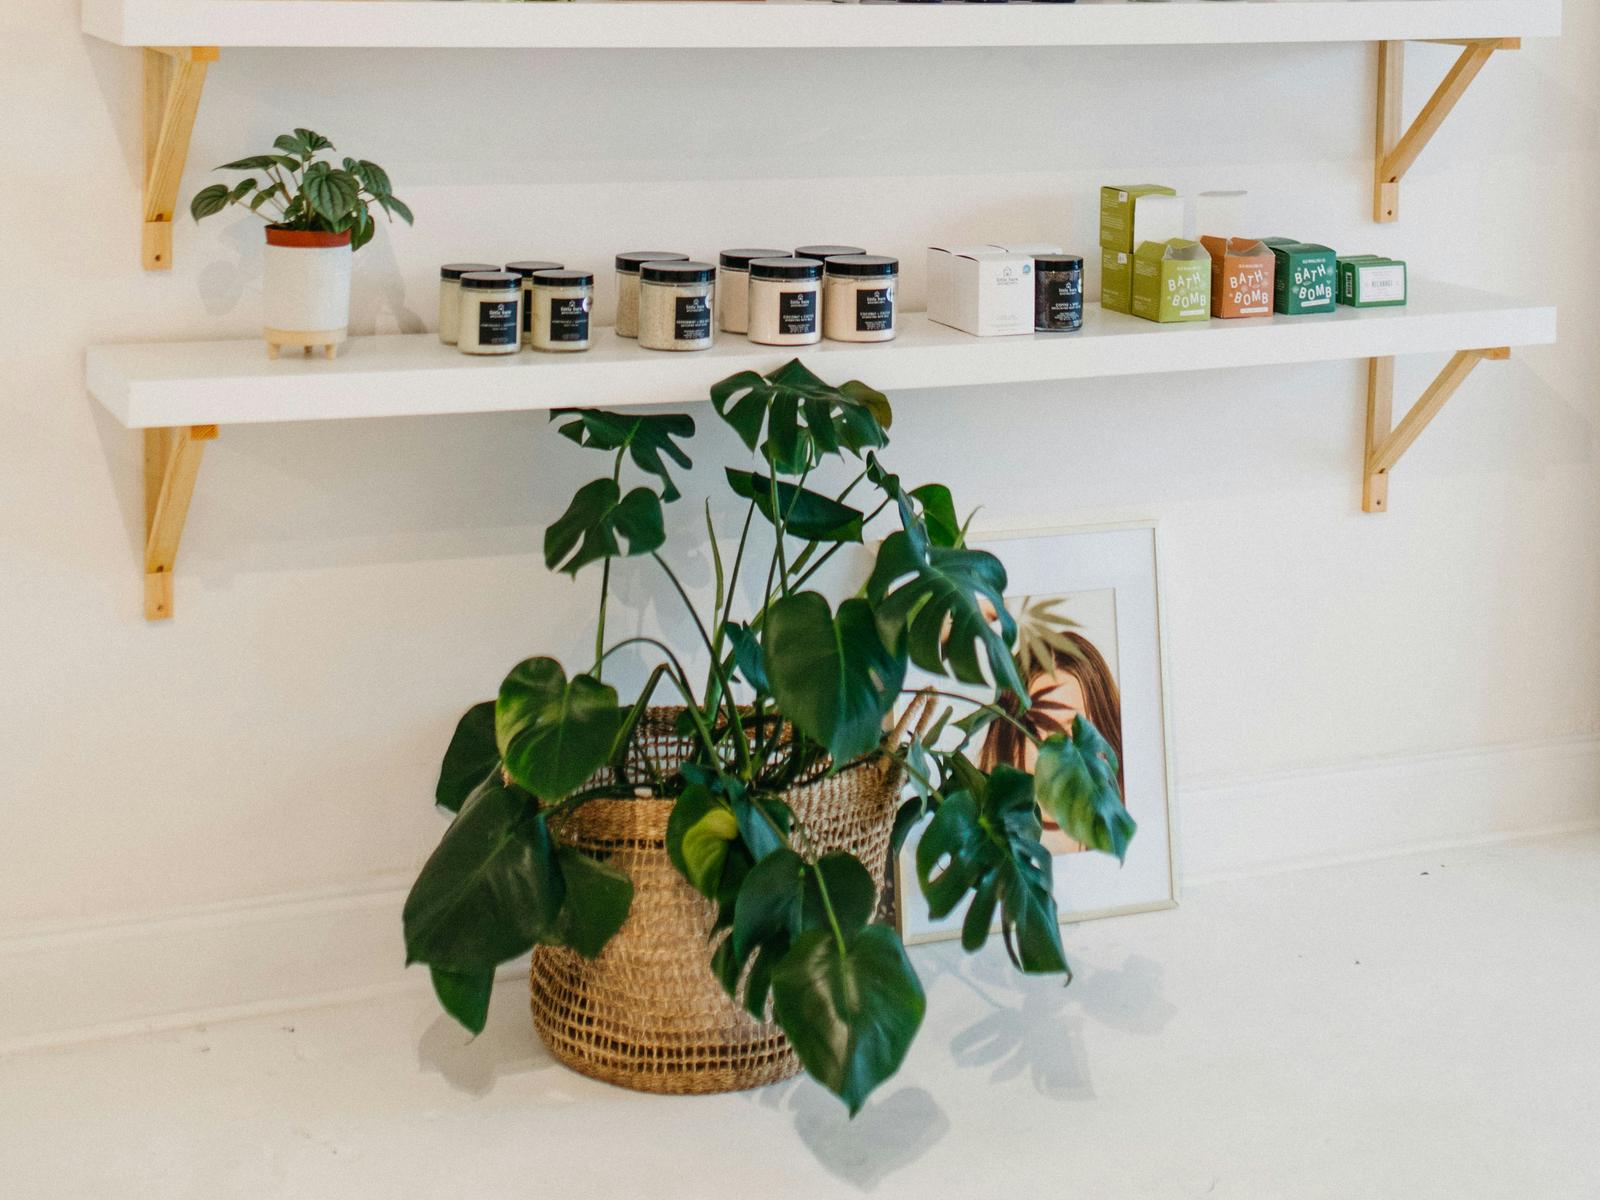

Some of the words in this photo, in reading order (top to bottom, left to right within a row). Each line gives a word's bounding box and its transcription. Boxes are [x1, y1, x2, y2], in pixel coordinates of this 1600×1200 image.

[1168, 272, 1200, 291] BATH
[1230, 270, 1263, 288] BATH
[1295, 264, 1326, 284] BATH
[1172, 292, 1206, 308] BOMB
[1234, 289, 1269, 305] BOMB
[1299, 283, 1332, 300] BOMB
